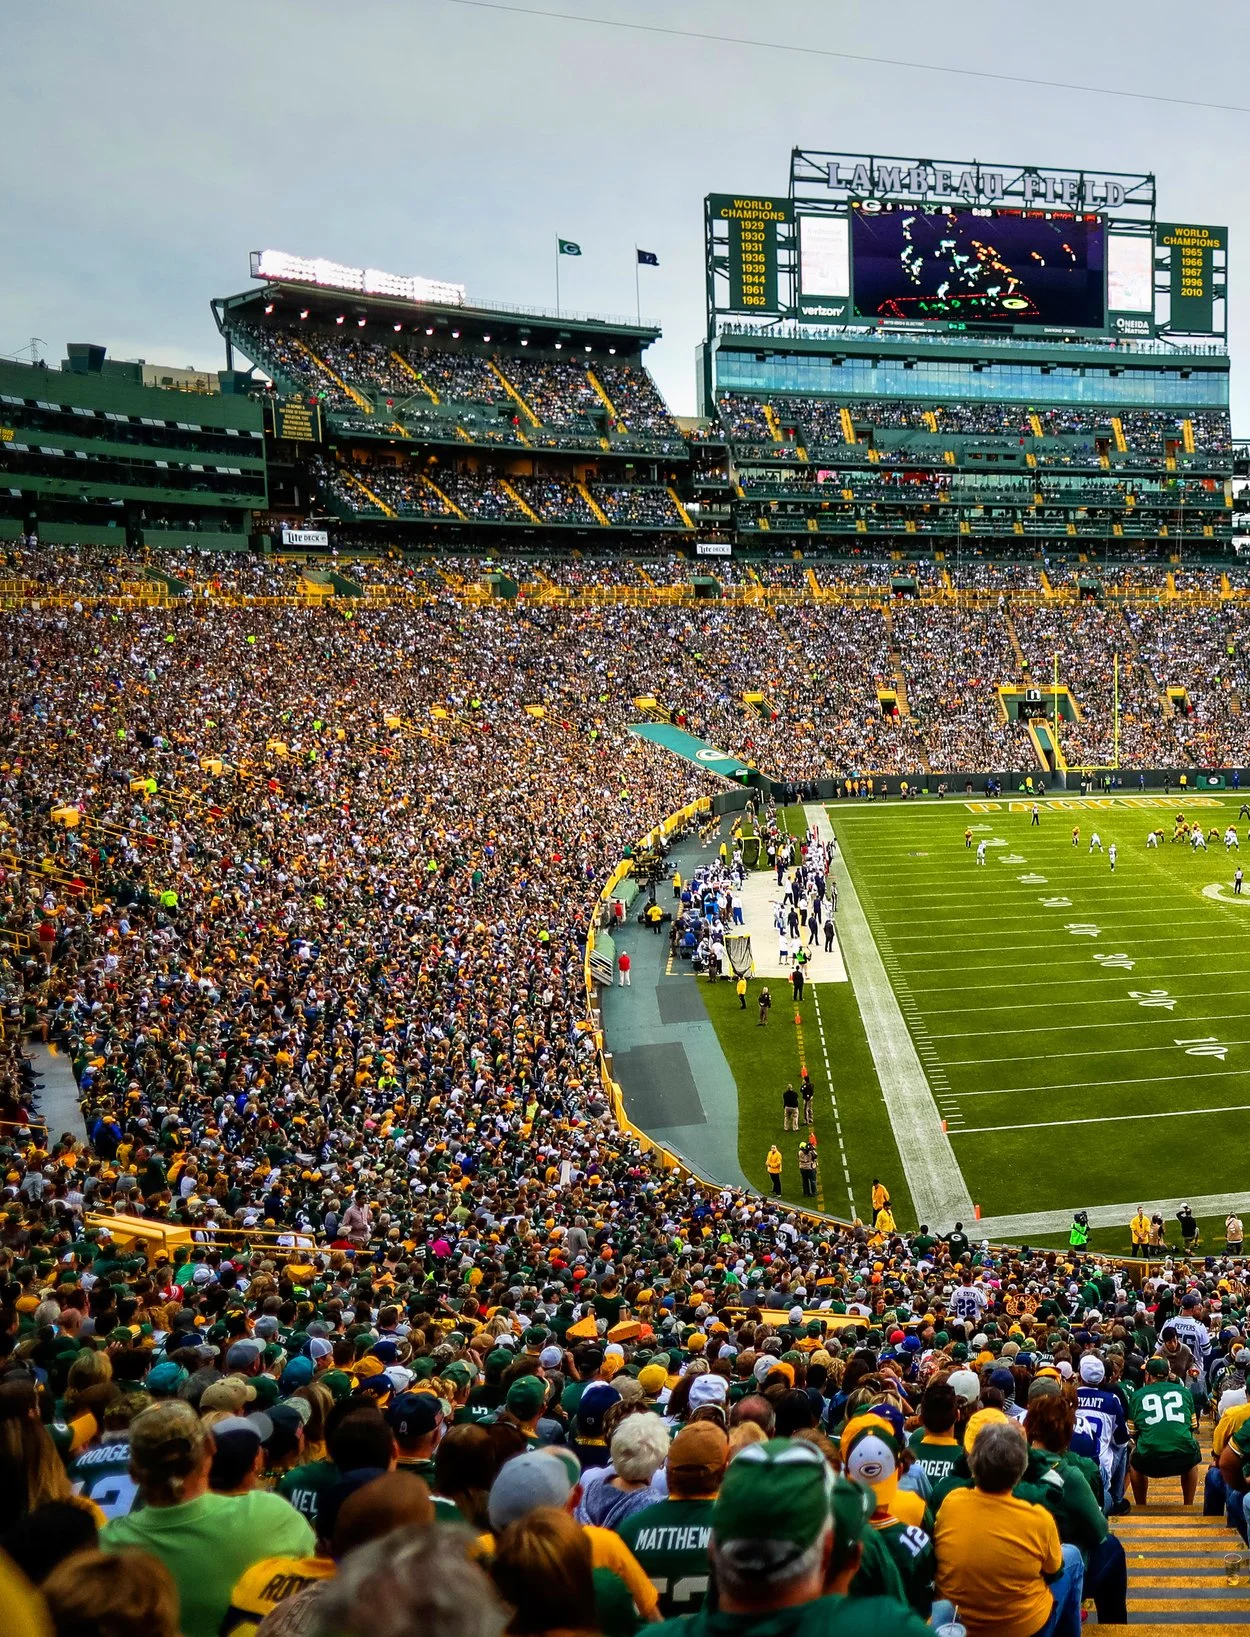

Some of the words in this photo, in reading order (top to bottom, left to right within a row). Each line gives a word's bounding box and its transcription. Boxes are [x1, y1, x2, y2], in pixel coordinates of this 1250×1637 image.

[827, 162, 1004, 199] LAMBEAU
[1023, 173, 1126, 207] FIELD
[734, 200, 772, 210] WORLD
[721, 209, 785, 220] CHAMPIONS
[740, 221, 764, 230] 1929
[740, 232, 765, 240] 1930
[1175, 228, 1209, 238] WORLD
[741, 242, 762, 251] 1931
[1163, 237, 1220, 248] CHAMPIONS
[1182, 248, 1202, 256] 1965
[741, 253, 765, 262] 1936
[1182, 258, 1203, 266] 1966
[742, 264, 765, 273] 1939
[1182, 268, 1202, 276] 1967
[742, 275, 766, 284] 1944
[1182, 278, 1203, 286] 1996
[742, 286, 764, 294] 1961
[1181, 288, 1203, 296] 2010
[742, 296, 766, 305] 1962
[801, 306, 842, 317] verizon
[1117, 318, 1149, 329] ONEIDA
[964, 797, 1225, 814] PACKERS
[1092, 953, 1136, 968] 30
[1128, 989, 1178, 1008] 20
[1173, 1036, 1229, 1057] 10
[958, 1298, 976, 1316] 22
[1175, 1323, 1195, 1331] PEPPERS
[1142, 1391, 1185, 1425] 92
[72, 1475, 140, 1518] 2
[291, 1488, 318, 1513] NEL
[634, 1526, 712, 1551] MATTHEW
[900, 1526, 929, 1557] 12
